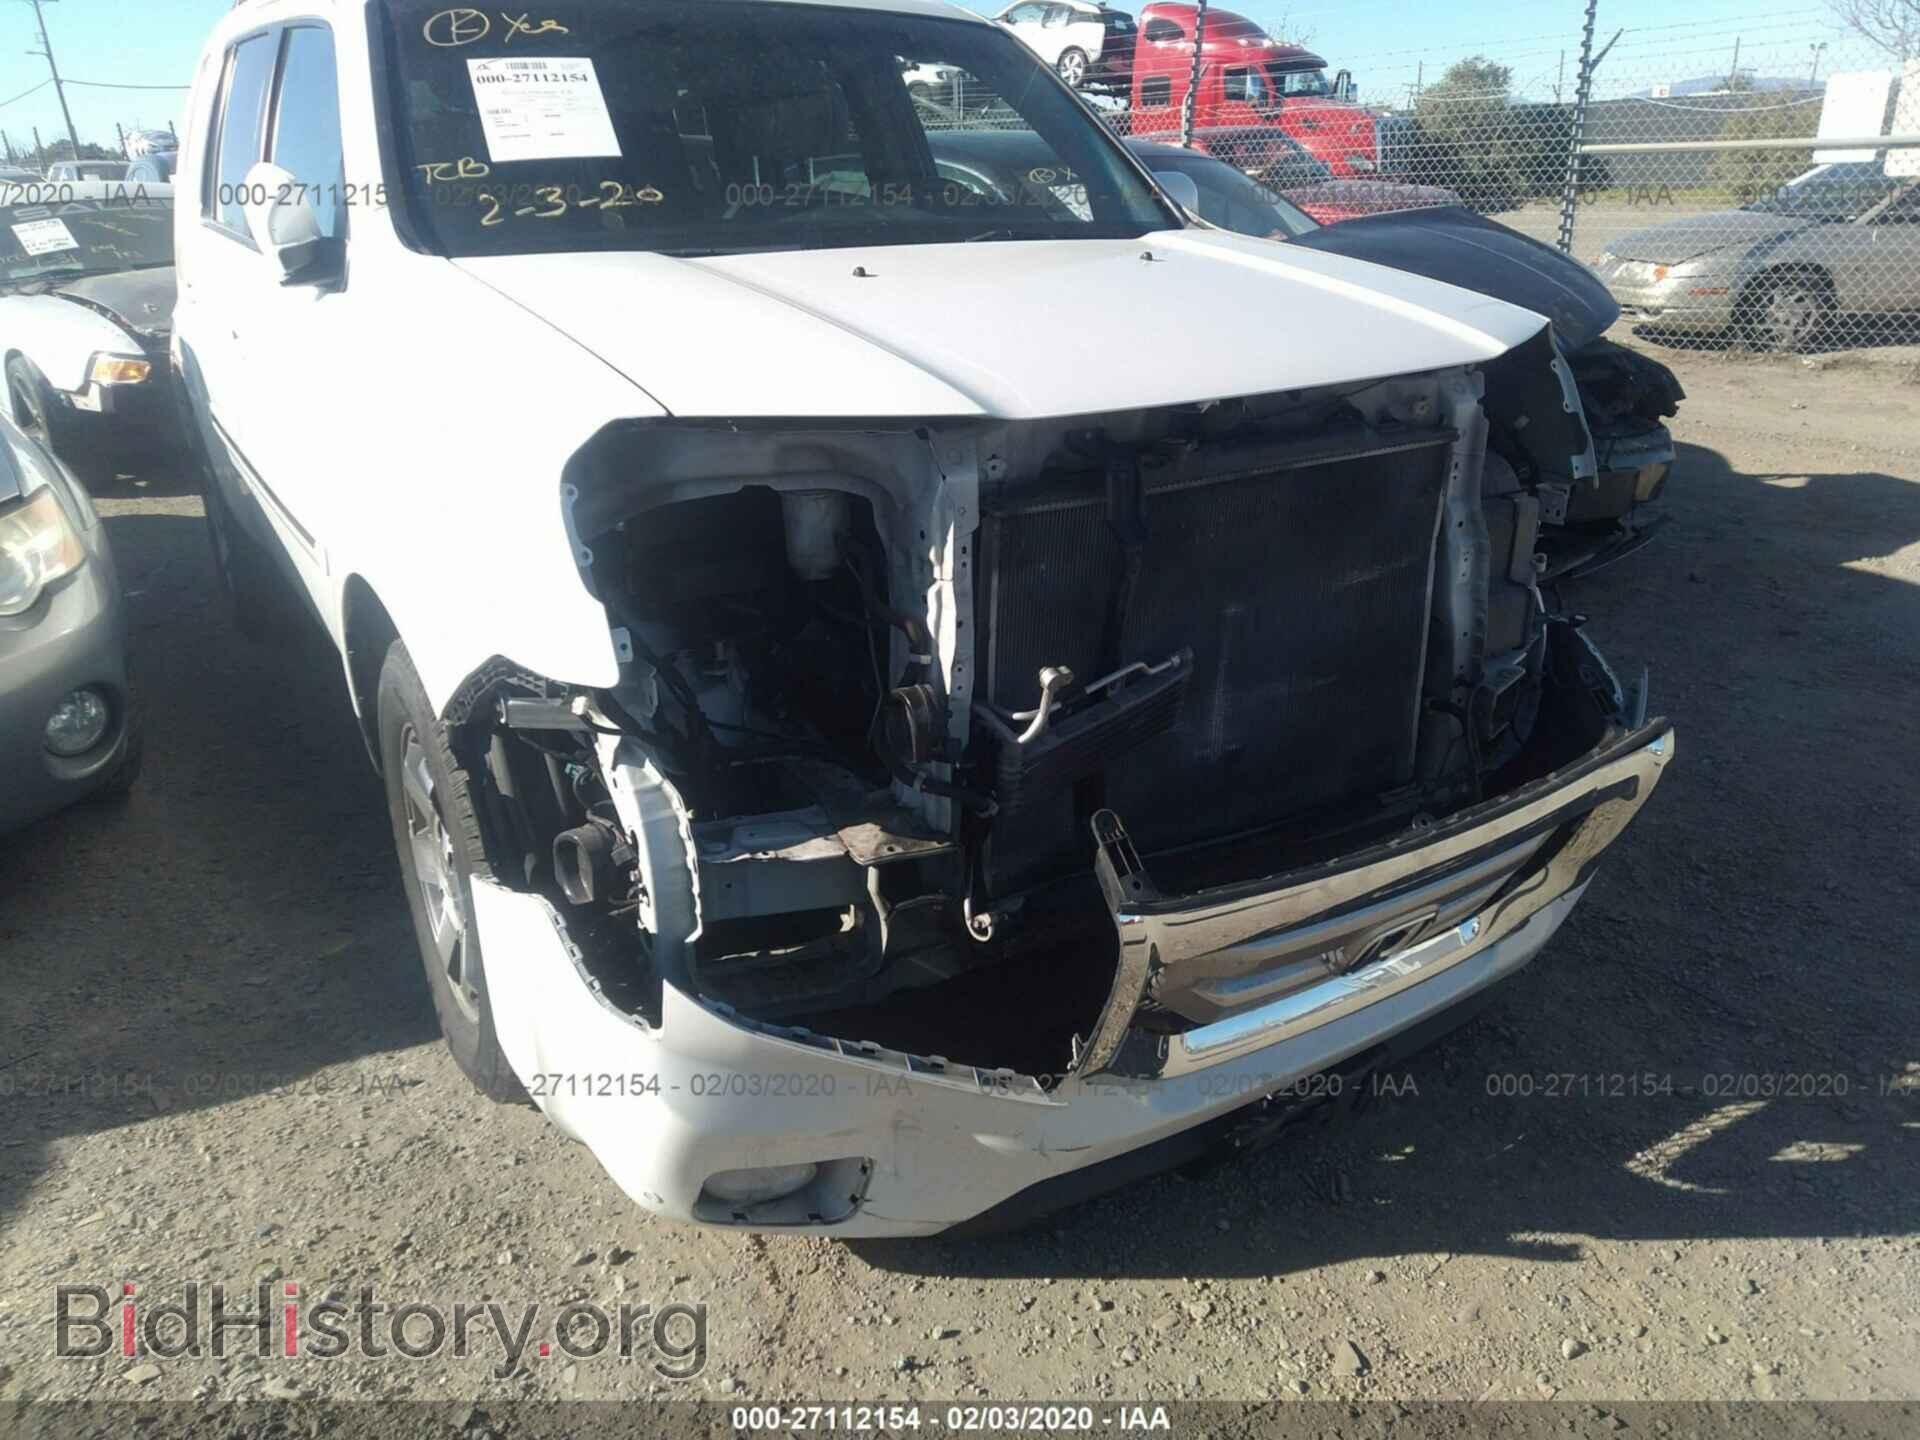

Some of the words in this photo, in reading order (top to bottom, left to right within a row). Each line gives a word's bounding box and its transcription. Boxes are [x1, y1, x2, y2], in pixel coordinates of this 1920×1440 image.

[476, 73, 588, 85] 000-27112154
[417, 157, 490, 185] TCB
[479, 180, 664, 225] 2-3-20
